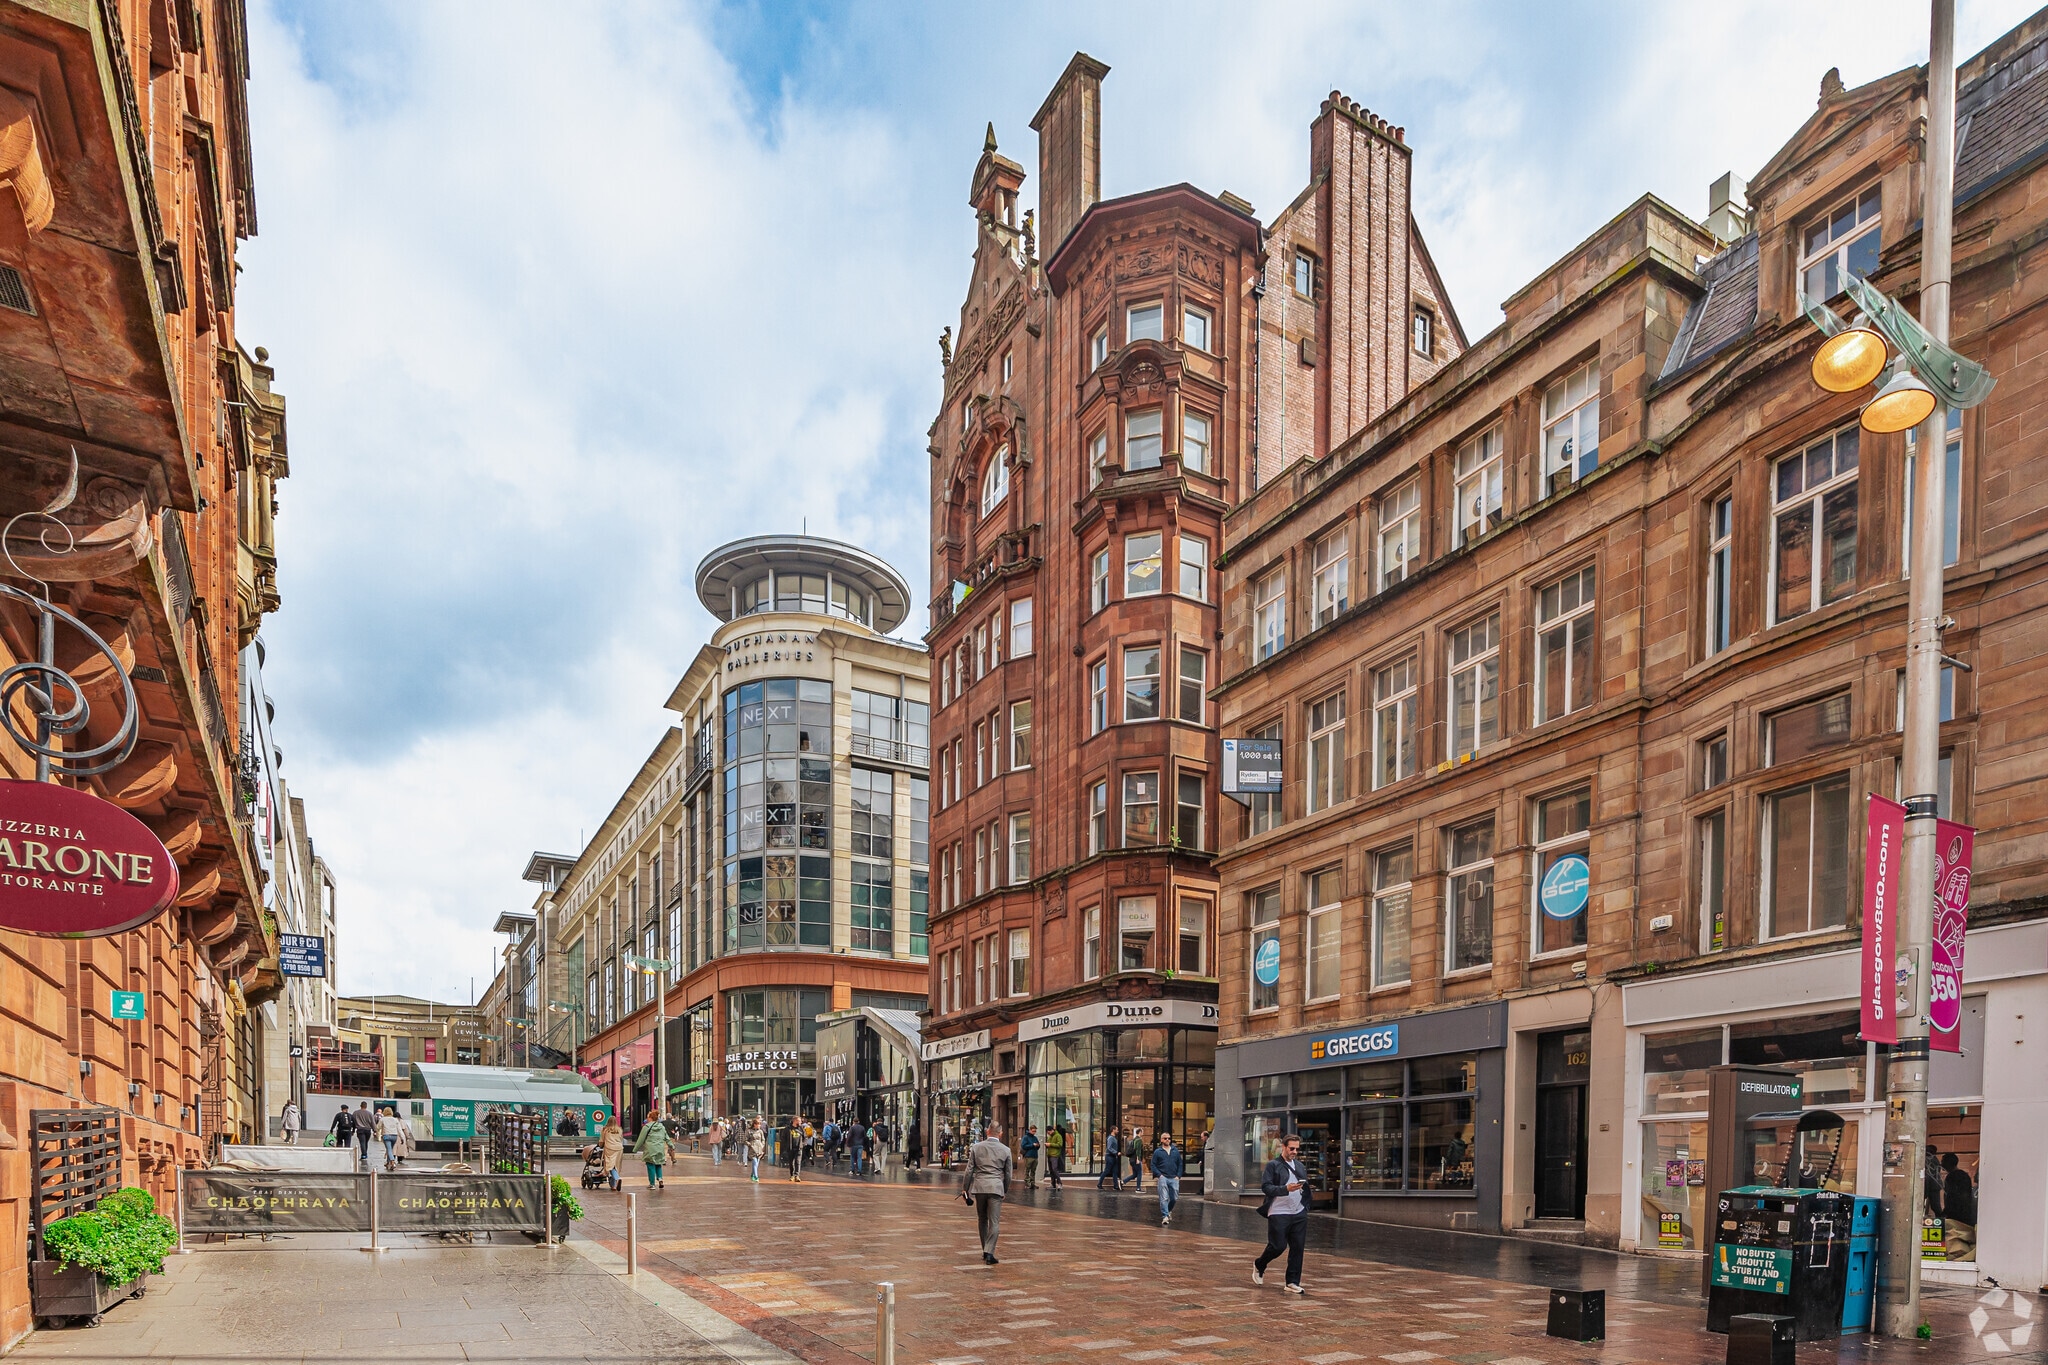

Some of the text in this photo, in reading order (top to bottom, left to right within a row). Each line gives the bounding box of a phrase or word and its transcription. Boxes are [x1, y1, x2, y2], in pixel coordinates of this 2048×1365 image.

[725, 633, 814, 655] BUCHANAN
[727, 650, 813, 672] GALLERIES
[743, 706, 791, 724] NEXT
[1240, 743, 1251, 751] For
[1262, 752, 1272, 760] sq
[743, 808, 791, 825] NEXT
[743, 905, 791, 920] NEXT
[1872, 824, 1890, 1020] glasgow850.com
[306, 938, 318, 949] CO
[1107, 1004, 1163, 1017] Dune
[1042, 1015, 1070, 1030] Dune
[1327, 1031, 1393, 1056] GREGGS
[290, 1047, 302, 1056] JD
[726, 1051, 797, 1062] ISLE OF SKYE
[1567, 1052, 1586, 1065] 162
[728, 1061, 792, 1072] CANDLE CO.
[1741, 1082, 1791, 1095] DEFIBRILLATOR
[442, 1104, 469, 1113] Subway
[207, 1196, 350, 1208] CHAOPHRAYA
[399, 1198, 525, 1208] CHAOPHRAYA
[1736, 1248, 1776, 1259] NO BUTTS
[1736, 1257, 1775, 1270] ABOUT IT,
[1731, 1266, 1779, 1278] STUB IT AND
[1743, 1276, 1757, 1285] BIN
[1758, 1278, 1767, 1286] IT
